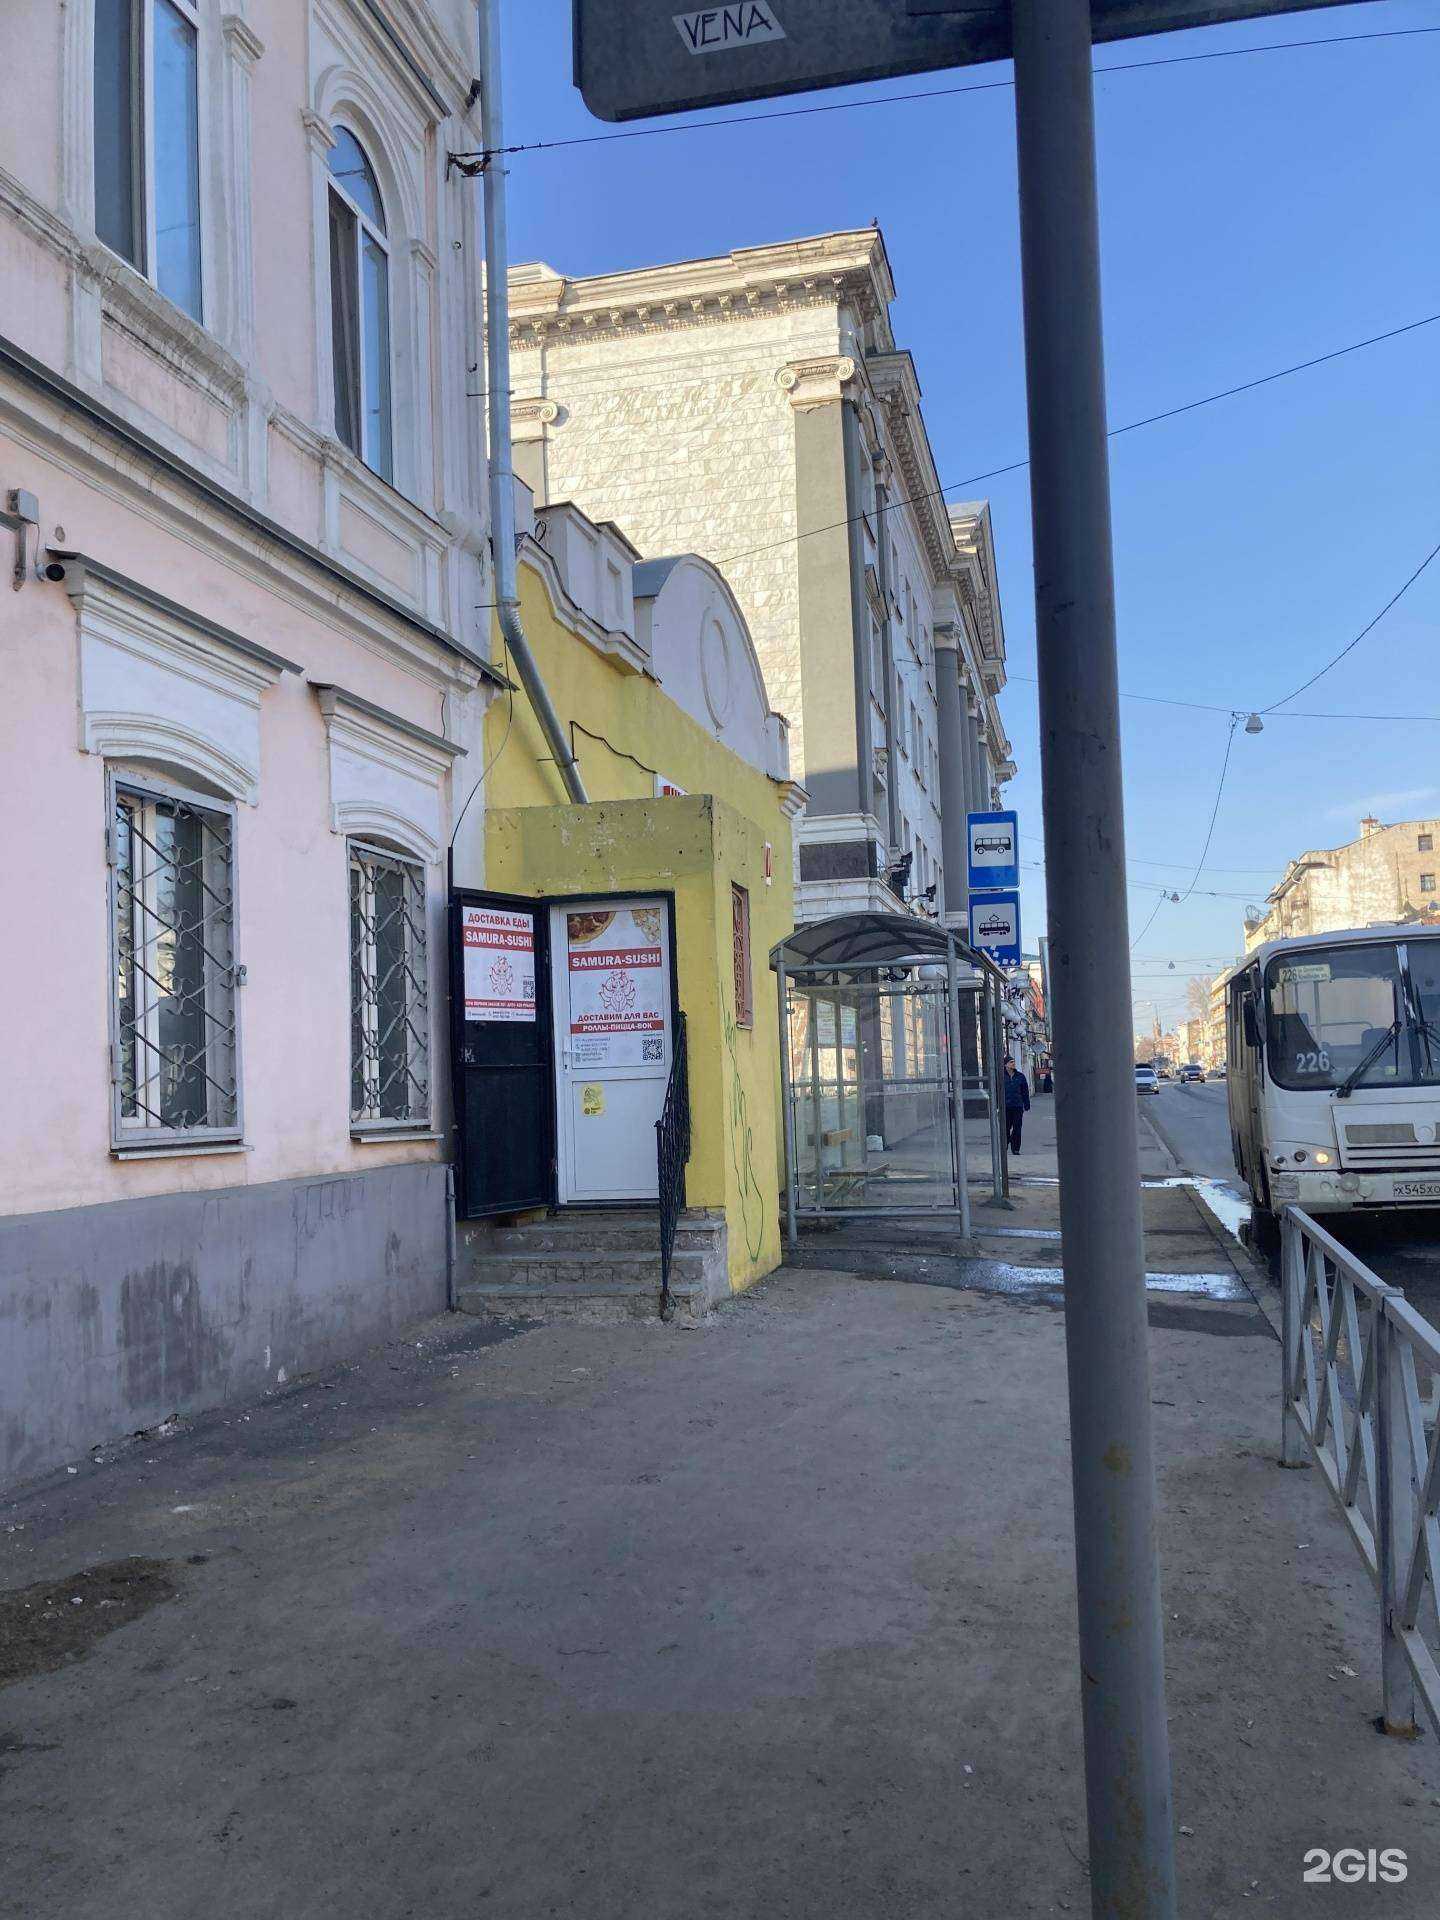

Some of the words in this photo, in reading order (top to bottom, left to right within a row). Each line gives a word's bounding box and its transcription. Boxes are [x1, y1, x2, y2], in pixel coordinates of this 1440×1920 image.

[683, 2, 772, 48] VENA
[468, 913, 511, 927] ДОСТАВКА
[512, 917, 530, 929] ЕДЫ
[465, 930, 532, 948] SAMURA-SUSHI
[572, 953, 660, 967] SAMURA-SUSHI
[1282, 968, 1297, 982] 226
[577, 1013, 622, 1023] ДОСТАВИМ
[624, 1012, 641, 1020] ДЛЯ
[642, 1011, 659, 1019] ВАС
[582, 1022, 653, 1032] РОЛЛЫ-ПИЦЦА-ВОК
[1296, 1051, 1330, 1074] 226
